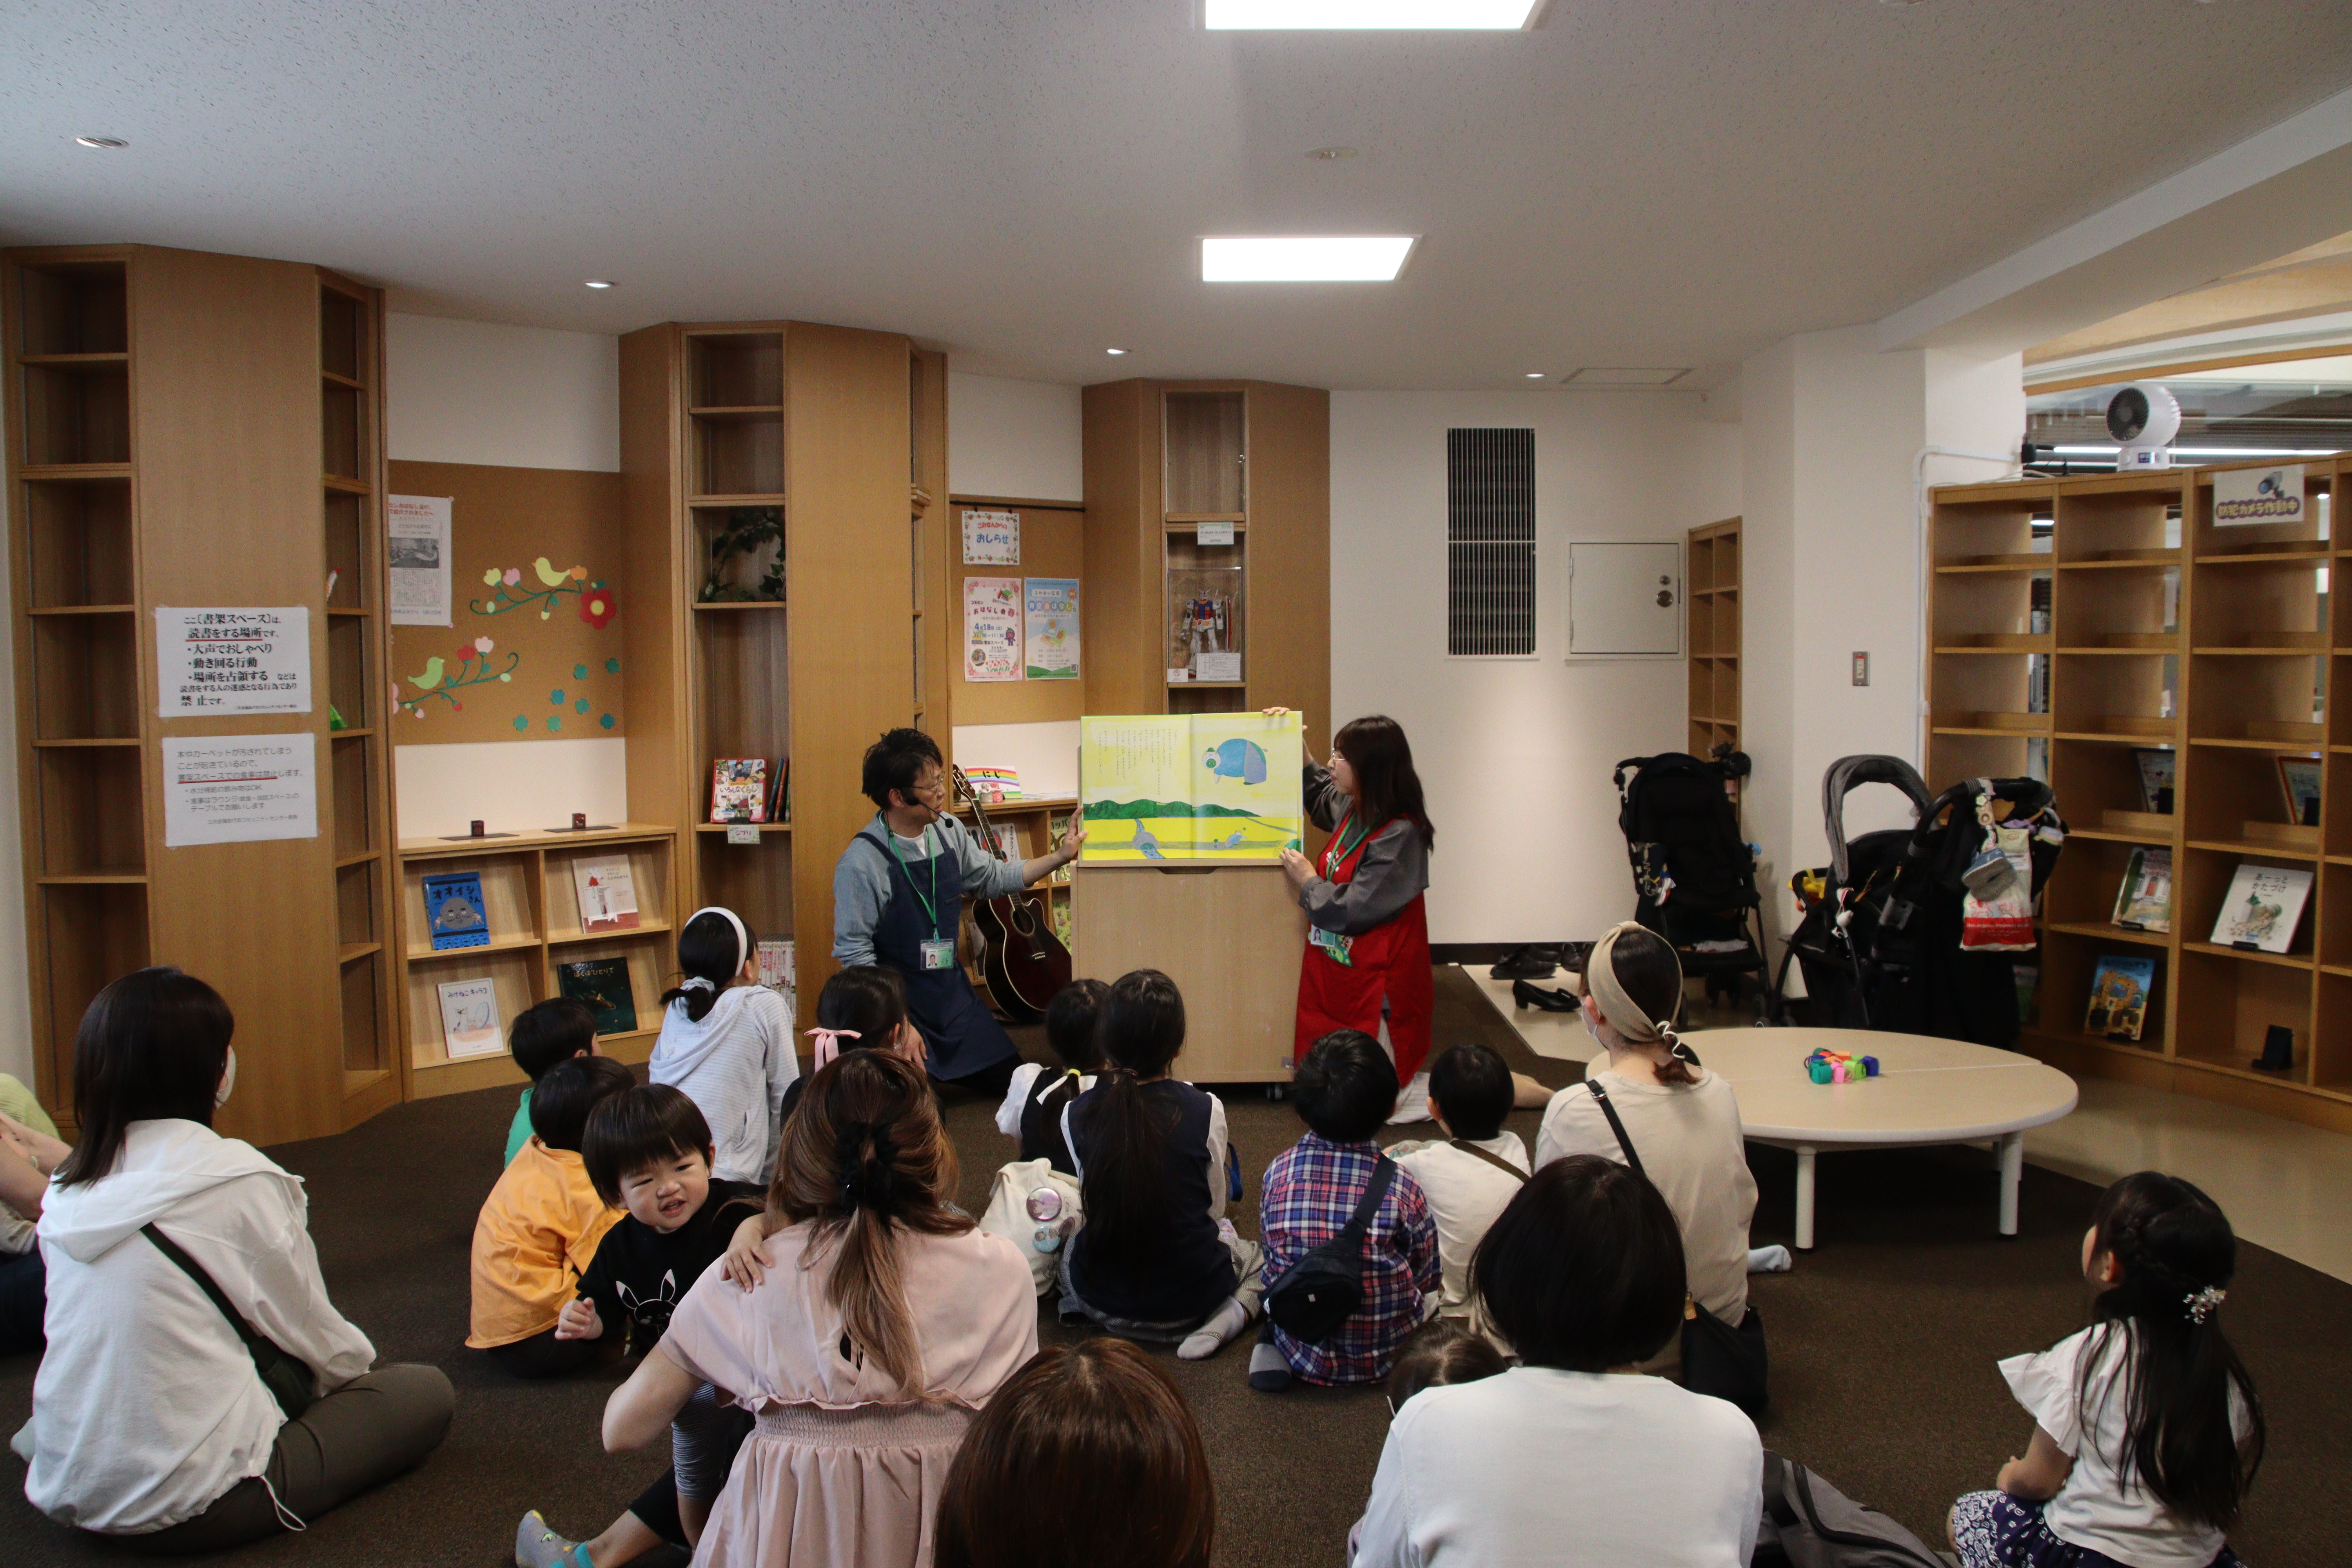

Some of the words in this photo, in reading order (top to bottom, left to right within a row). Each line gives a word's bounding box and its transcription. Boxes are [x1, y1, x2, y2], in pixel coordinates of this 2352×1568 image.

[2218, 498, 2298, 517] 防犯カメラ作動中
[976, 533, 1009, 544] おしらせ
[188, 627, 279, 638] 読書をする場所です。
[177, 747, 292, 757] 本やカーペットが汚されてしまう
[983, 770, 1002, 779] にじ
[720, 785, 757, 793] いろんなくらし
[433, 885, 474, 899] オオイシ
